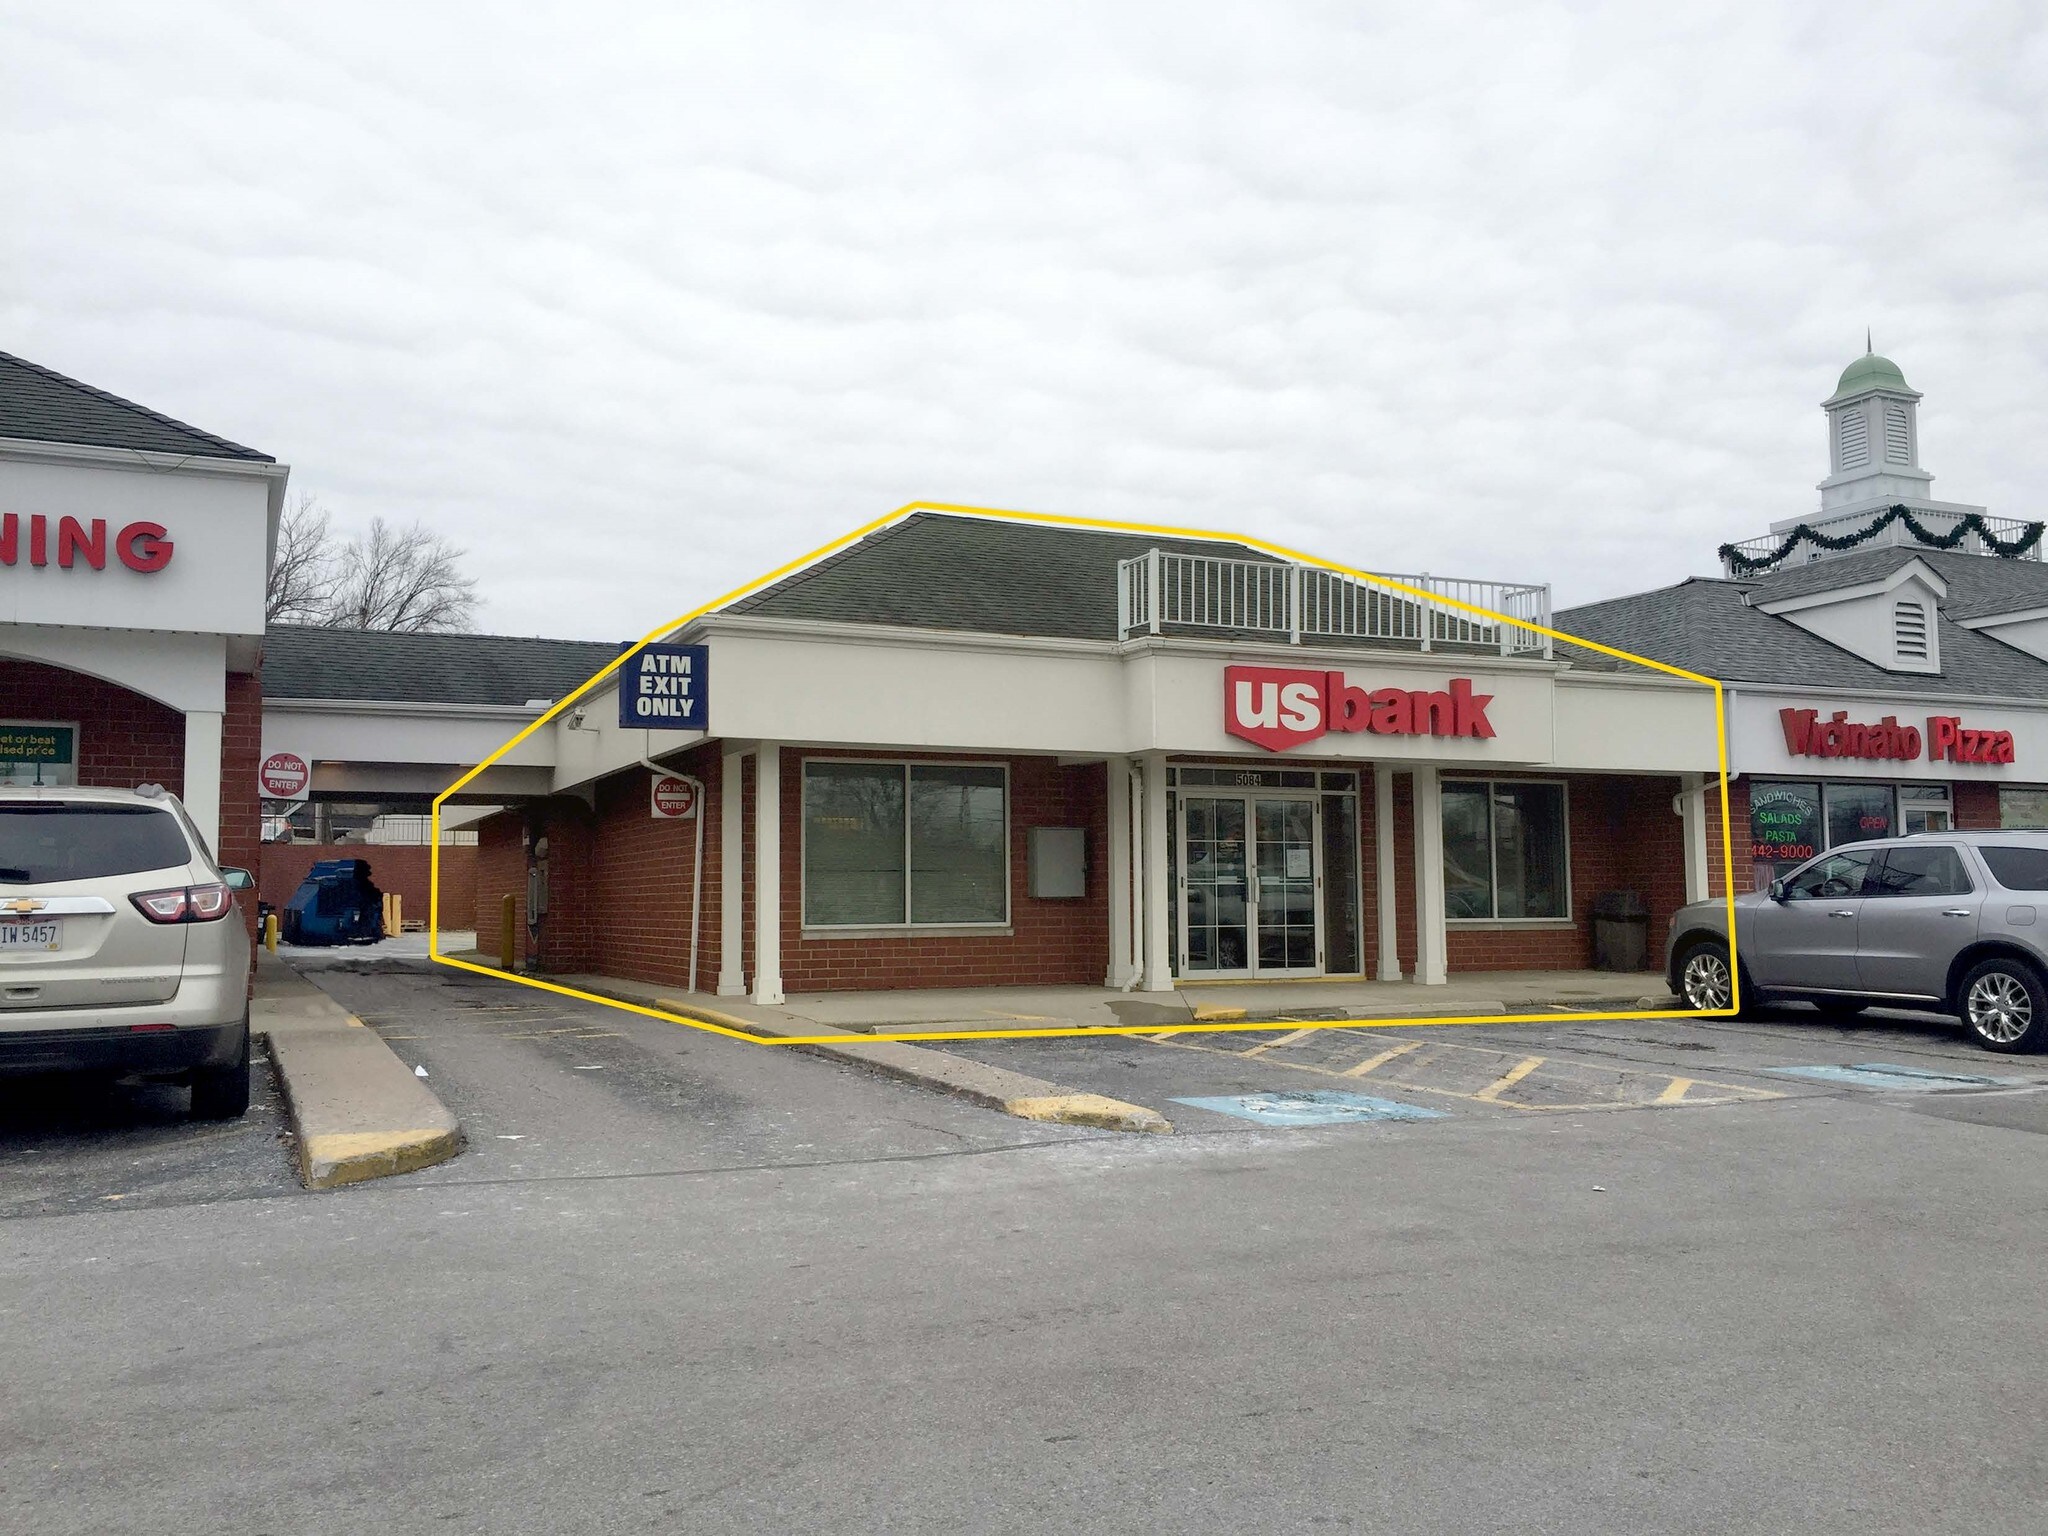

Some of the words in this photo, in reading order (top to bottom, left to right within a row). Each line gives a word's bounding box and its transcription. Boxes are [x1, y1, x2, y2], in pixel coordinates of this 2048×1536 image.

[640, 654, 692, 674] ATM
[639, 675, 692, 695] EXIT
[636, 696, 694, 717] ONLY
[15, 736, 28, 744] or
[30, 734, 56, 745] beat
[1779, 708, 1922, 760] Vicinato
[1926, 716, 2015, 763] Pizza
[268, 760, 281, 769] DO
[284, 761, 303, 771] NOT
[269, 779, 298, 789] ENTER
[1236, 773, 1261, 786] 5084
[658, 783, 671, 792] DO
[673, 784, 688, 792] NOT
[661, 801, 686, 809] ENTER
[1750, 790, 1813, 817] SANDWICHES
[1759, 811, 1802, 825] SALADS
[1859, 816, 1888, 829] OPEN
[1765, 830, 1797, 842] PASTA
[22, 926, 56, 943] 5457
